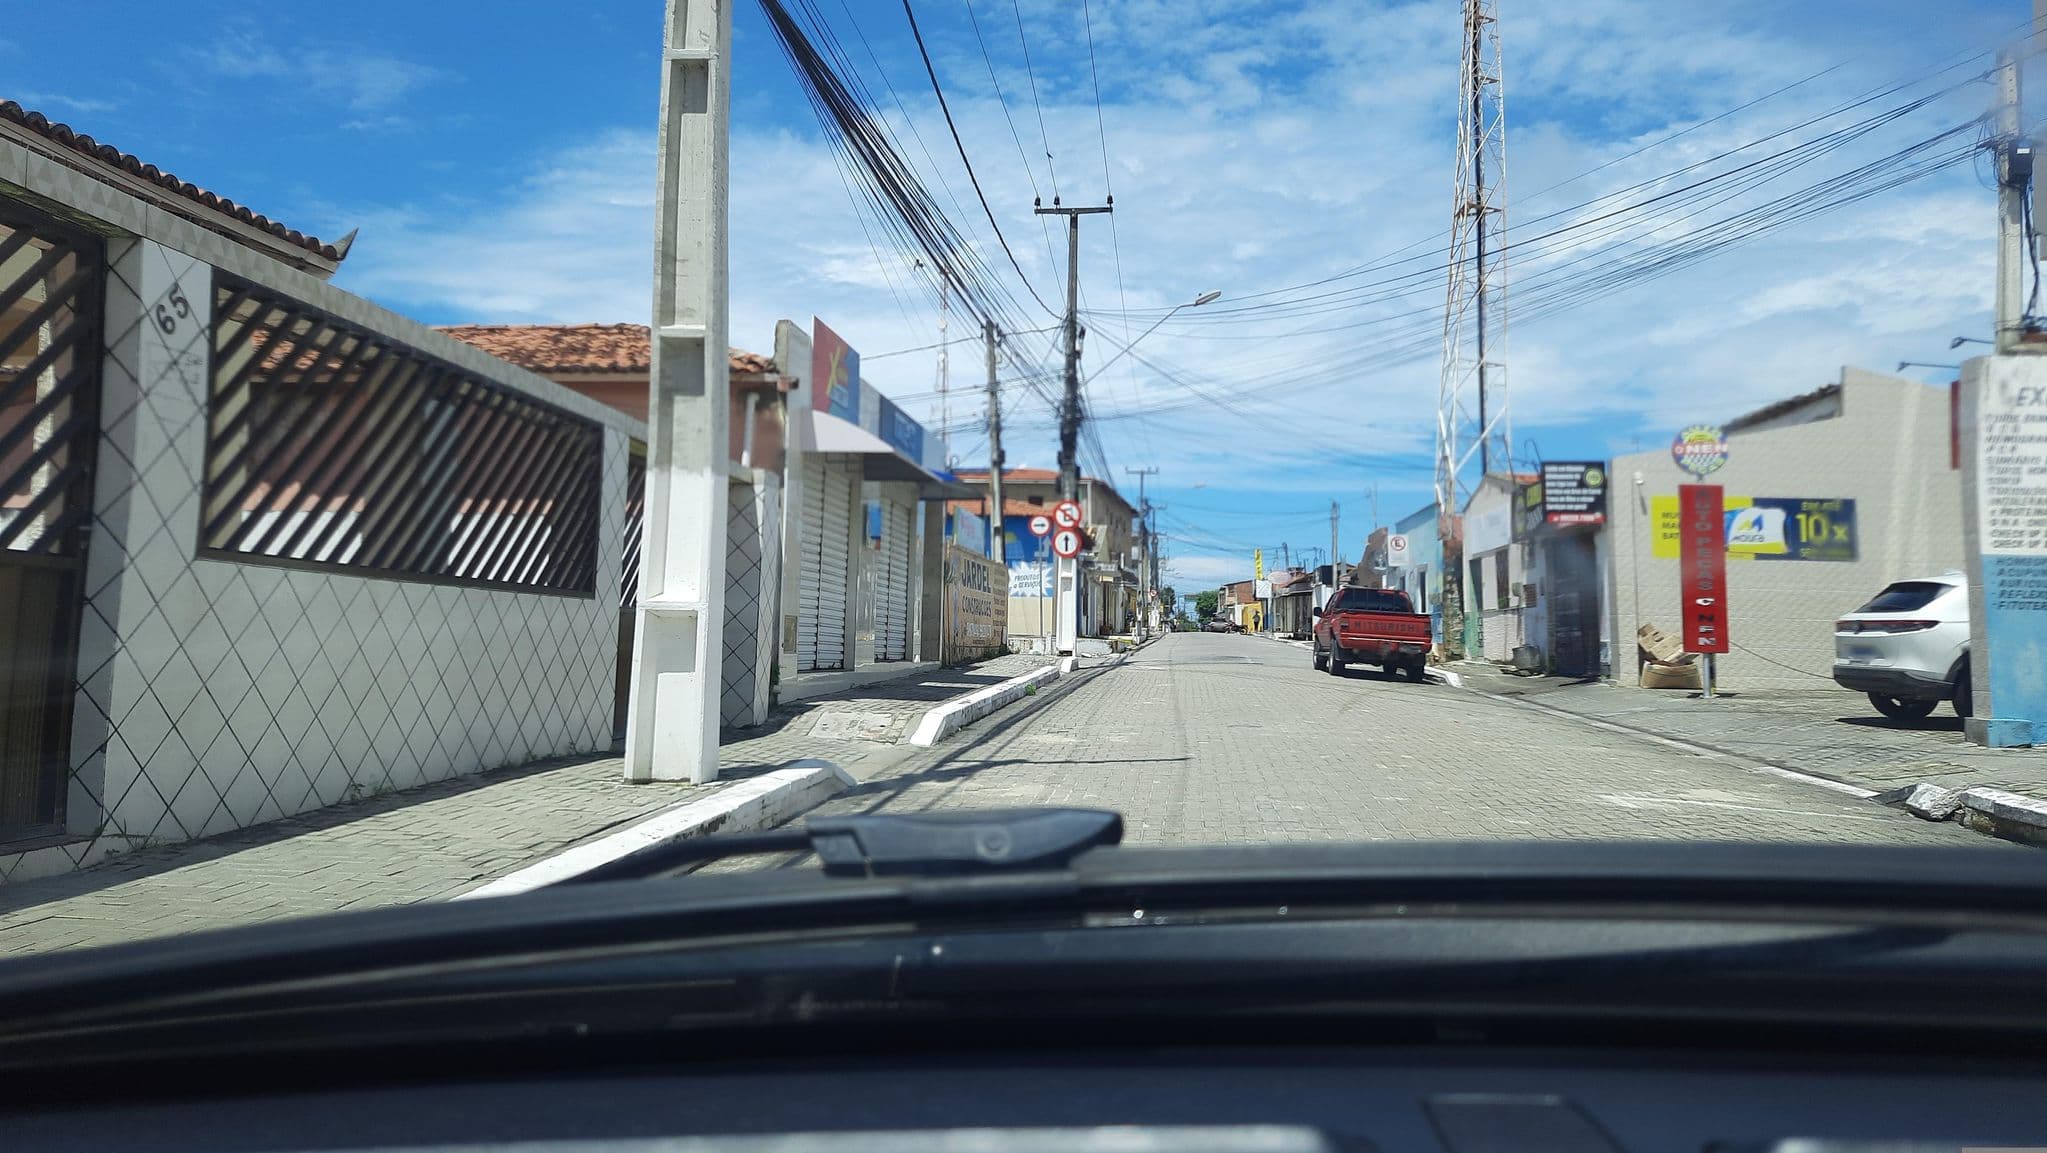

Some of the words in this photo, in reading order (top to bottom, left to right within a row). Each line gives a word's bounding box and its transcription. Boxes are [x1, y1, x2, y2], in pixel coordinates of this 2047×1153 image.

[156, 281, 188, 335] 65
[1794, 513, 1827, 546] 10
[961, 559, 992, 593] JARDEL
